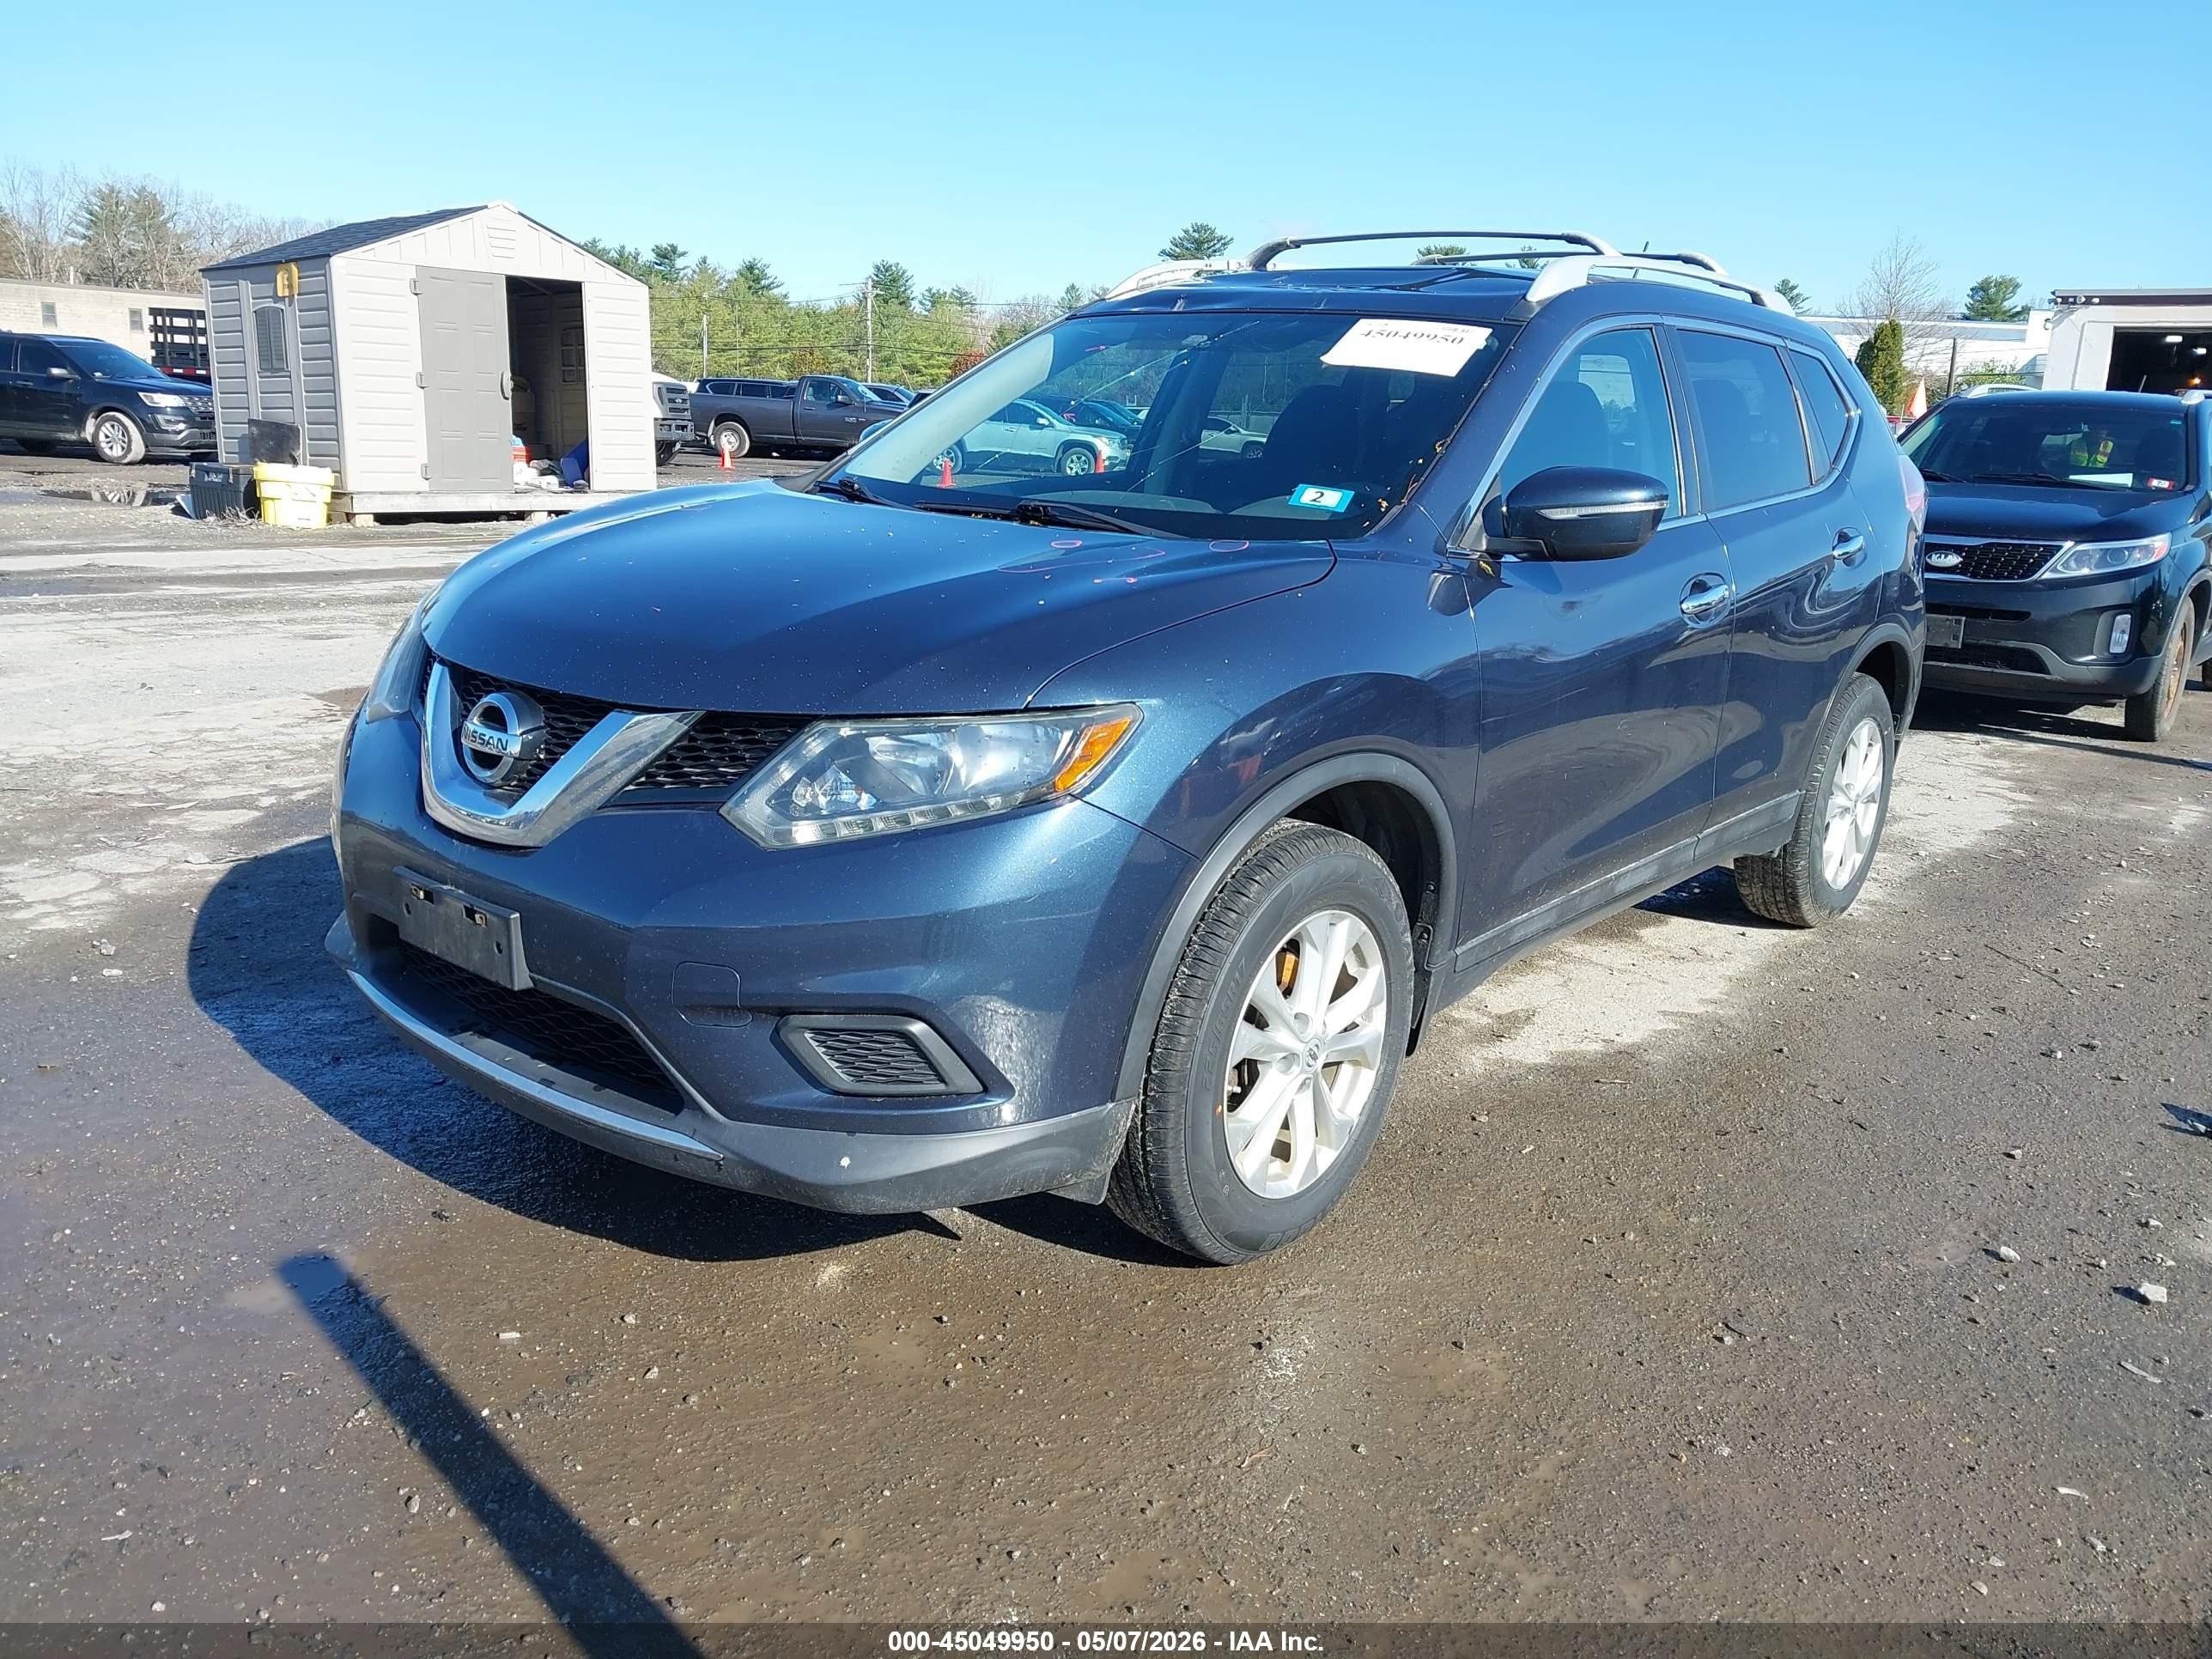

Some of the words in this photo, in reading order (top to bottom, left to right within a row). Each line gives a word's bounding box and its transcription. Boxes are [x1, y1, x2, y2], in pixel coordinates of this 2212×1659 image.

[1359, 329, 1465, 345] 45049950
[1310, 490, 1325, 504] 2
[1931, 553, 1959, 564] KIA
[464, 724, 509, 752] NISSAN
